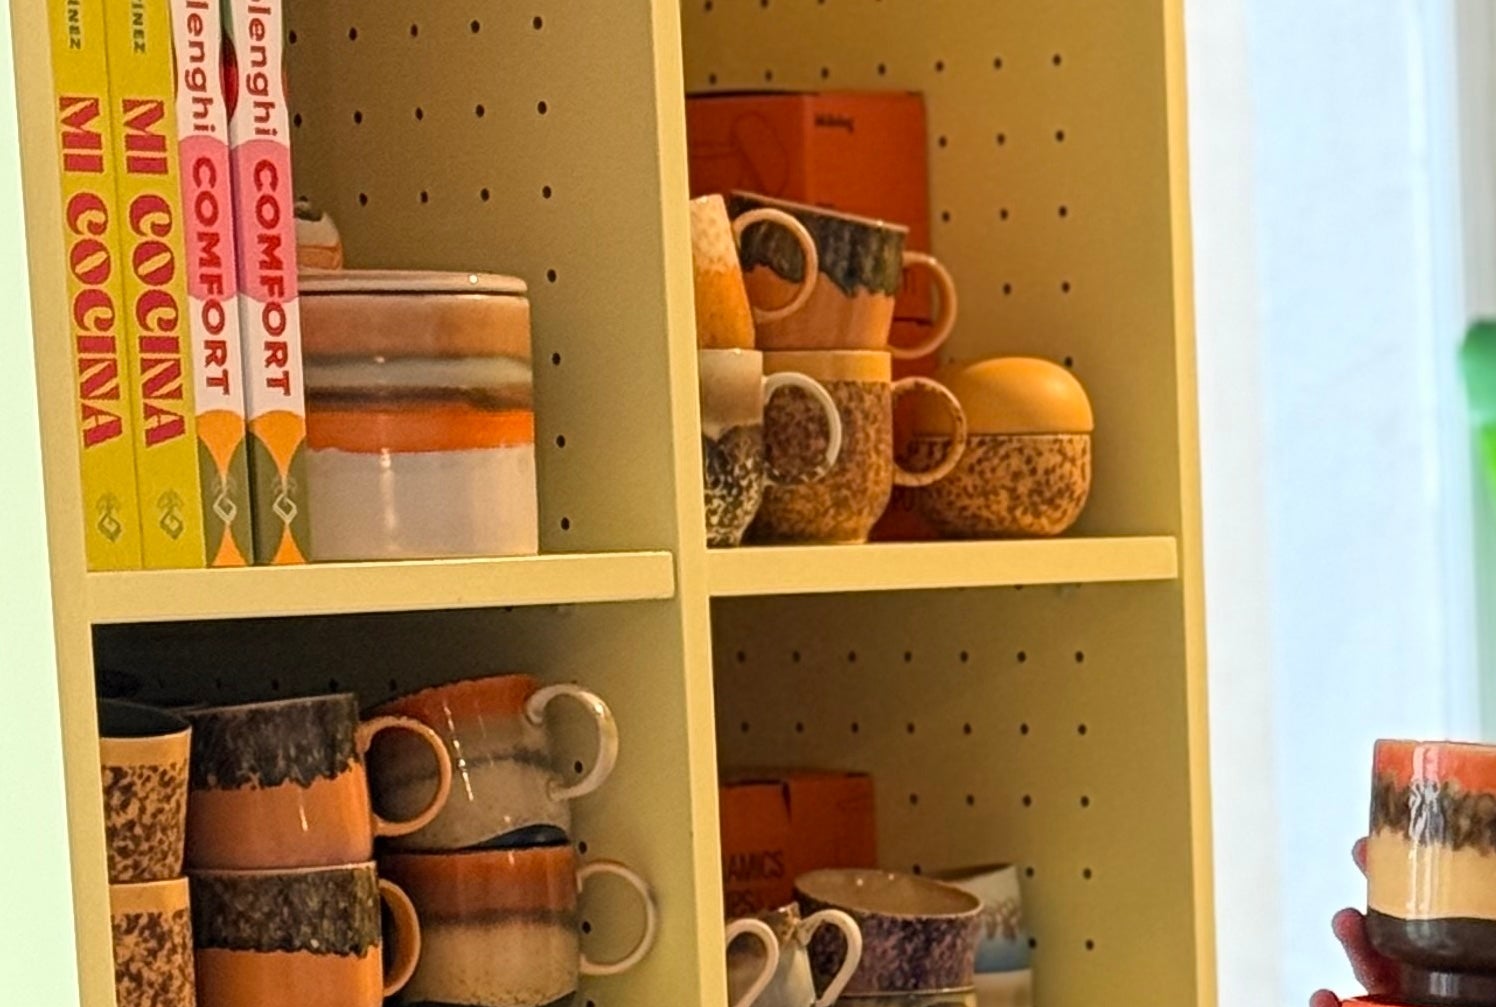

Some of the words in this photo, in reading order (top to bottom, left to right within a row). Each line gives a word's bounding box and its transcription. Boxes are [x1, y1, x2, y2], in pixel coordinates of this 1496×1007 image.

[66, 0, 82, 50] INEZ
[130, 0, 146, 54] INEZ
[184, 0, 216, 132] lenghi
[246, 0, 278, 136] lenghi
[59, 96, 104, 172] MI
[122, 98, 168, 174] MI
[67, 192, 123, 449] COCINA
[129, 194, 186, 449] COCINA
[192, 156, 230, 395] COMFORT
[253, 159, 291, 397] COMFORT
